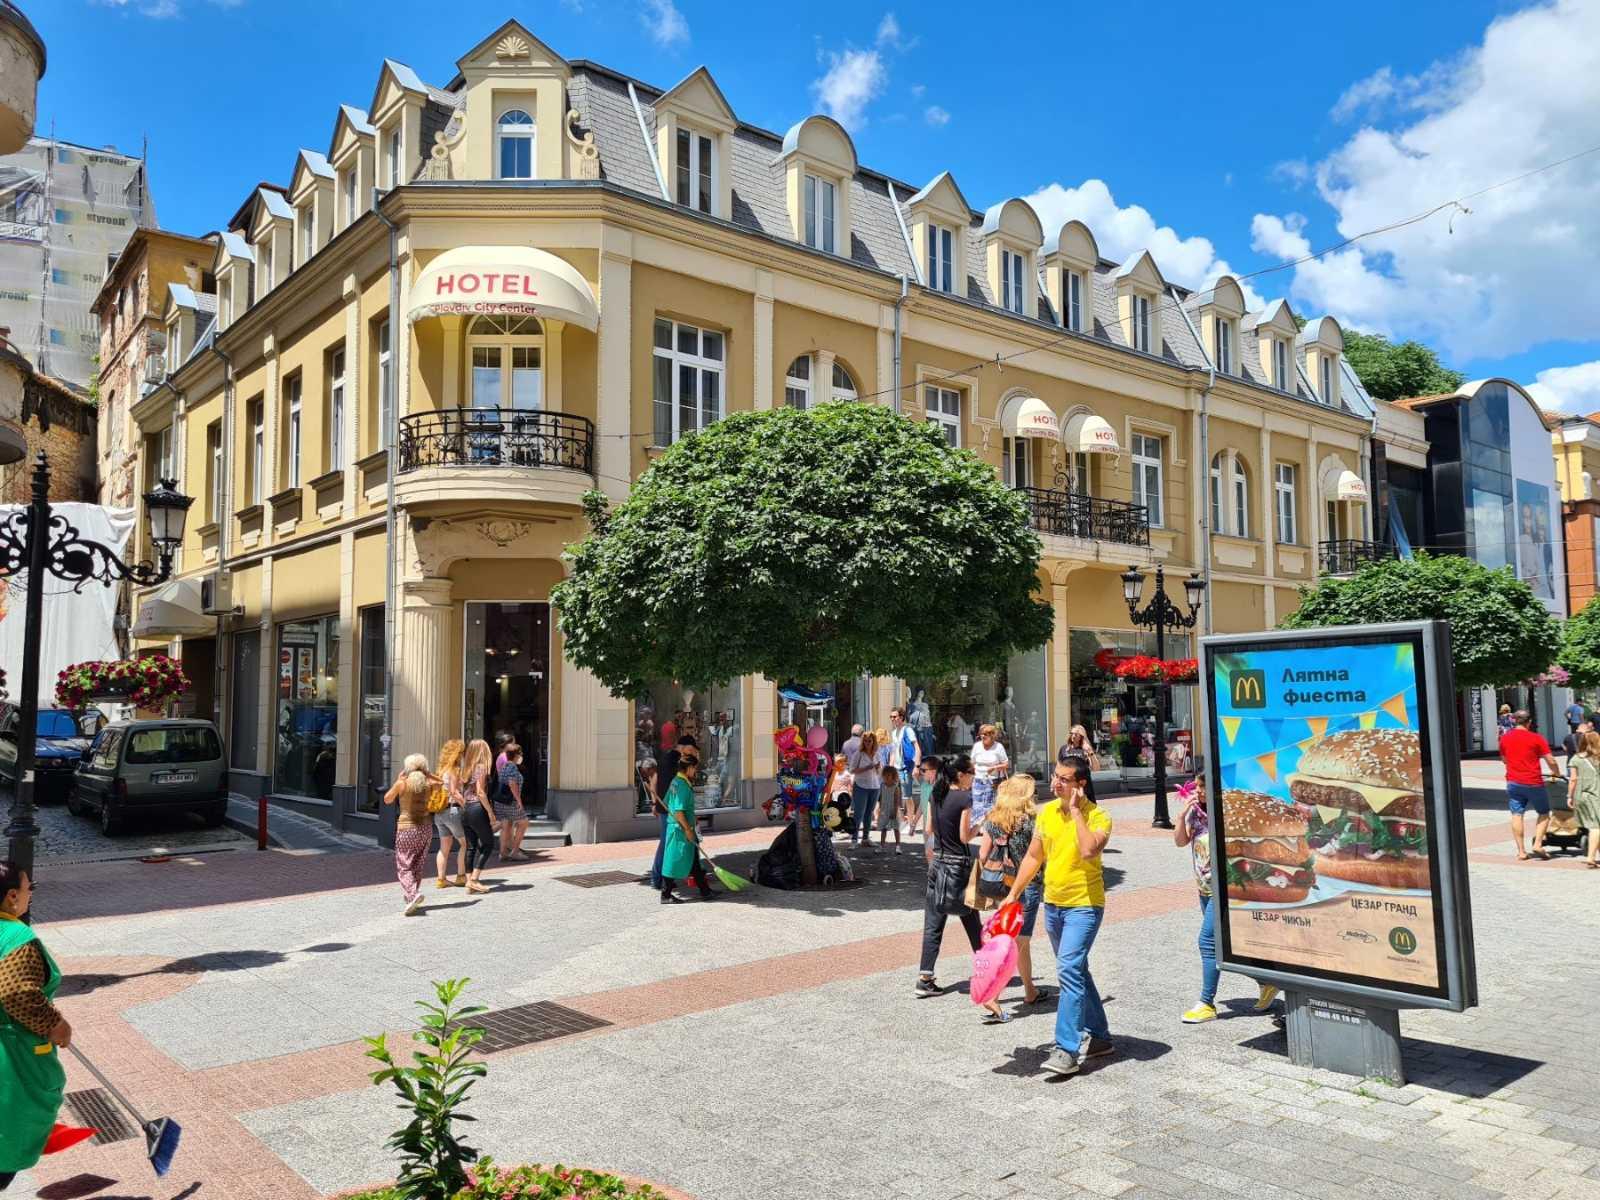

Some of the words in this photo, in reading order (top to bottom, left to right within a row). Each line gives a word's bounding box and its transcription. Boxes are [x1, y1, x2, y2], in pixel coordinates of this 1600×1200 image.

[436, 273, 538, 296] HOTEL
[434, 303, 470, 313] Plovdiv
[474, 302, 496, 313] City
[498, 303, 536, 314] Center
[1282, 668, 1349, 683] Лятна
[1283, 688, 1367, 707] фиеста
[1351, 898, 1382, 910] ЦЕЗАР
[1384, 902, 1417, 917] ГРАНД
[1252, 910, 1279, 922] ЦЕЗАР
[1281, 914, 1312, 928] ЧИКЪН
